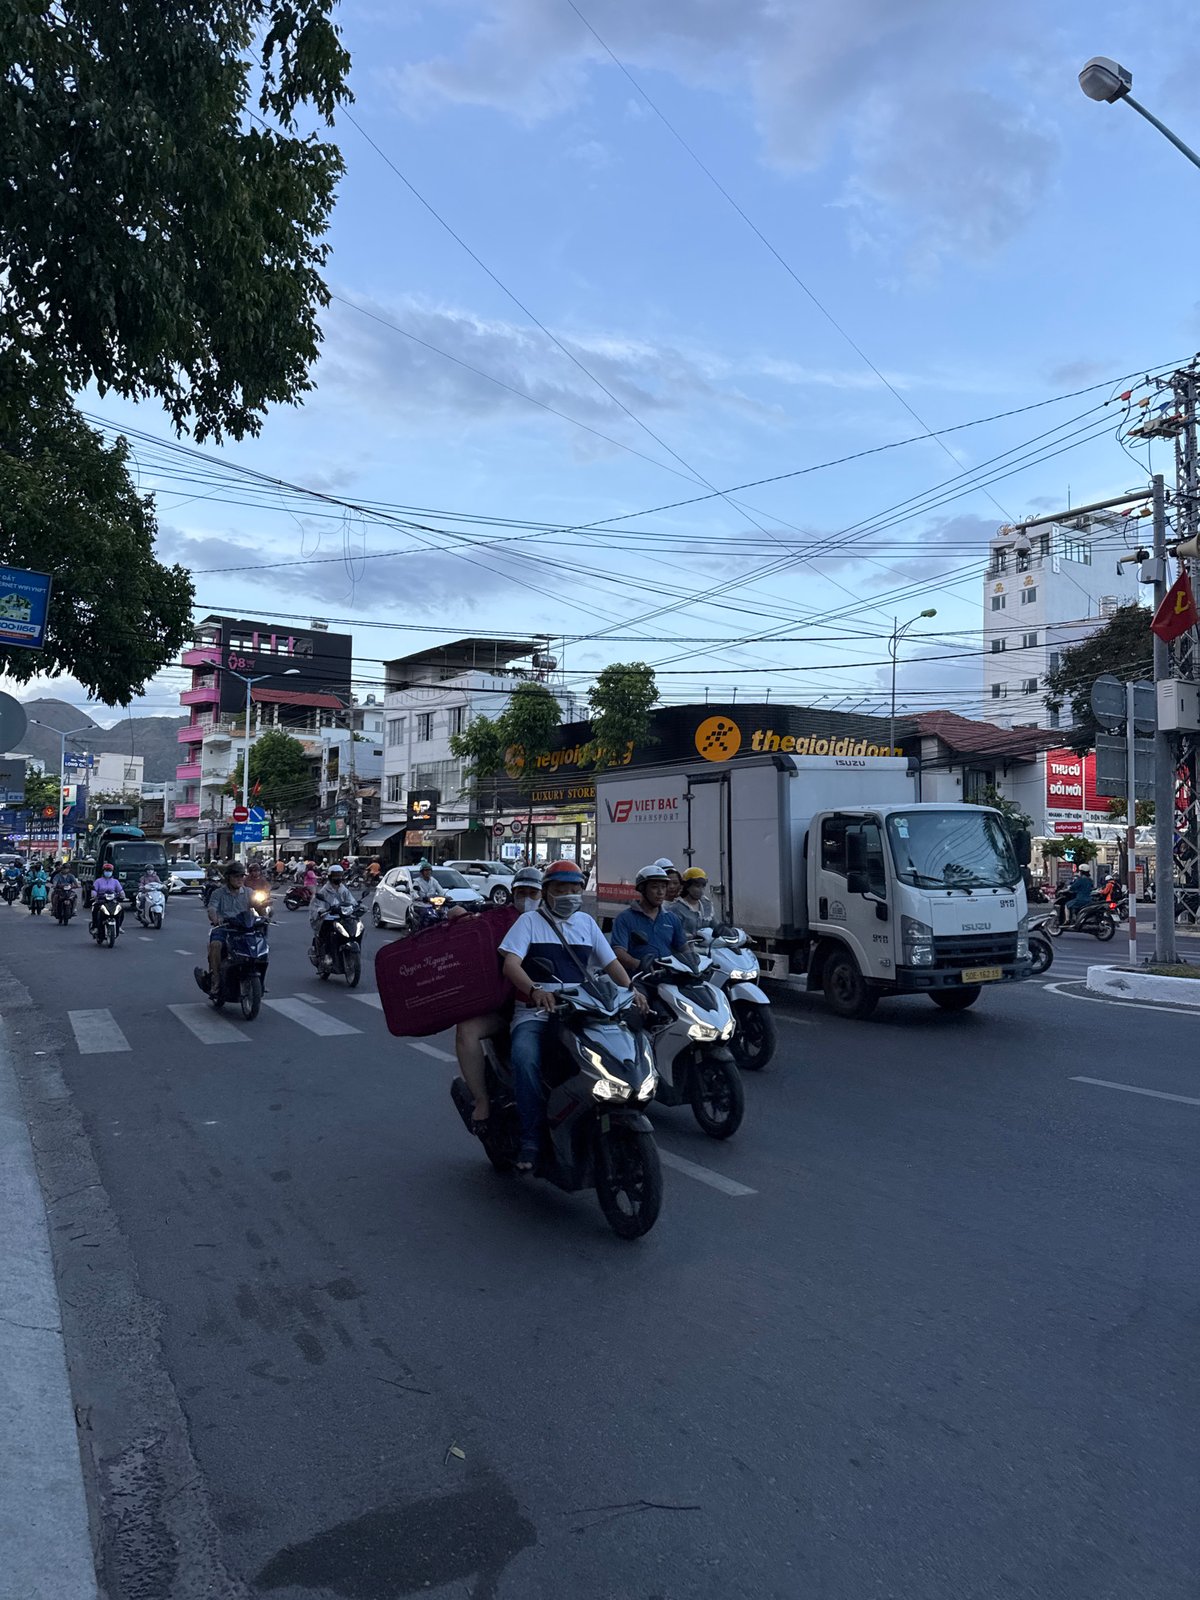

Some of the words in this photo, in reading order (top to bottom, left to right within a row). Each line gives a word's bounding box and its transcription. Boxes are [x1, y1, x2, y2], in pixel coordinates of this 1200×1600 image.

[836, 759, 866, 767] ISUZU
[1051, 763, 1068, 775] THU
[532, 789, 564, 801] LUXURY
[568, 787, 595, 798] STORE
[1050, 780, 1065, 796] ĐỔI
[1065, 783, 1082, 797] MỚI
[635, 799, 657, 811] VIET
[658, 797, 678, 810] BAC
[635, 813, 679, 822] TRANSPORT
[962, 922, 992, 932] ISUZU
